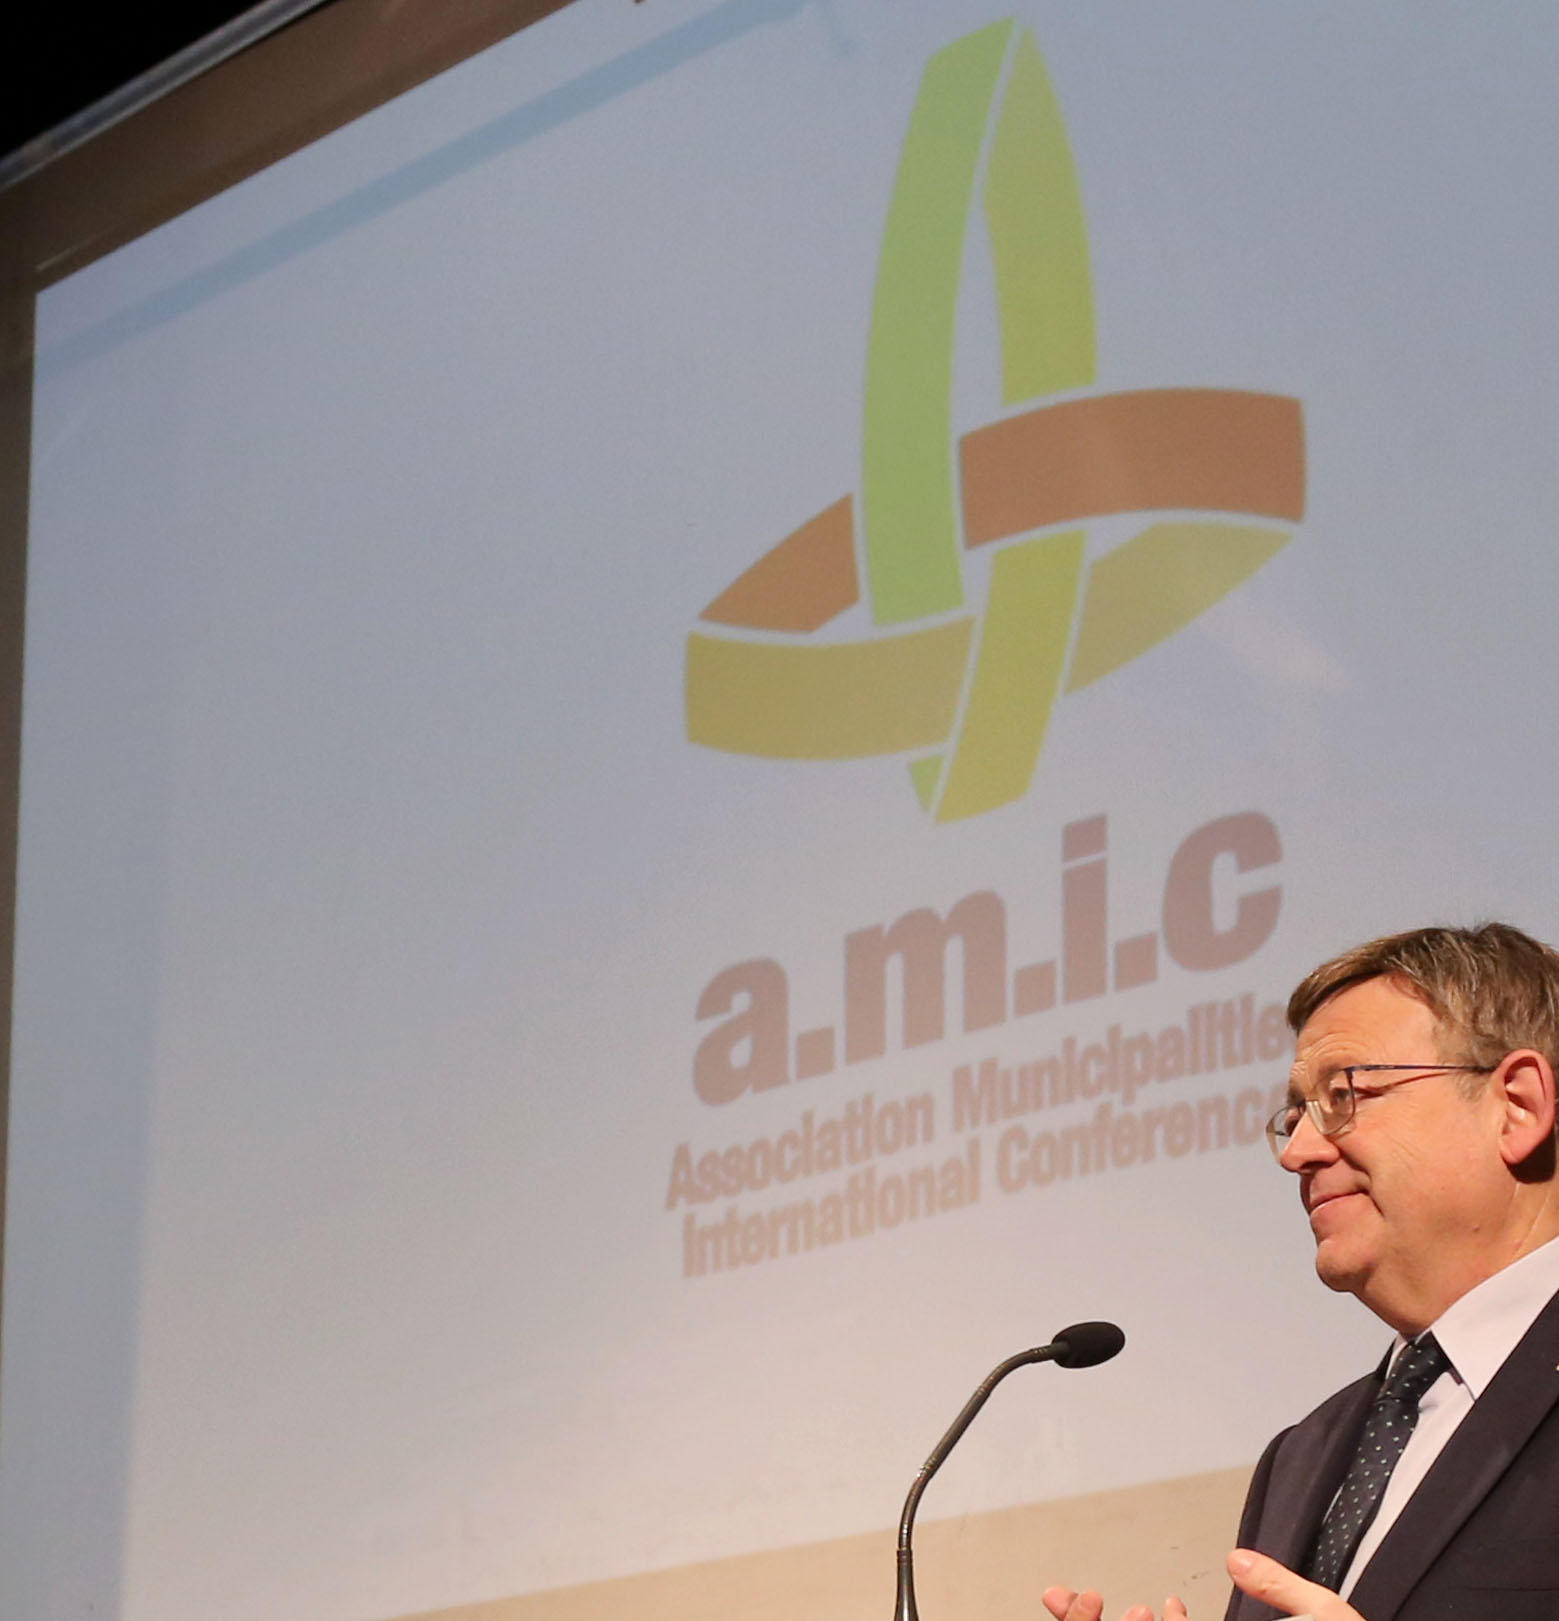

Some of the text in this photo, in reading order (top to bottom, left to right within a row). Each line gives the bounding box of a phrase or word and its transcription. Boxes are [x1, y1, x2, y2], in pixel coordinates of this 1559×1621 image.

[692, 810, 1284, 1108] a.m.i.c
[665, 993, 1292, 1213] Association Municipalitie
[682, 1134, 981, 1278] International
